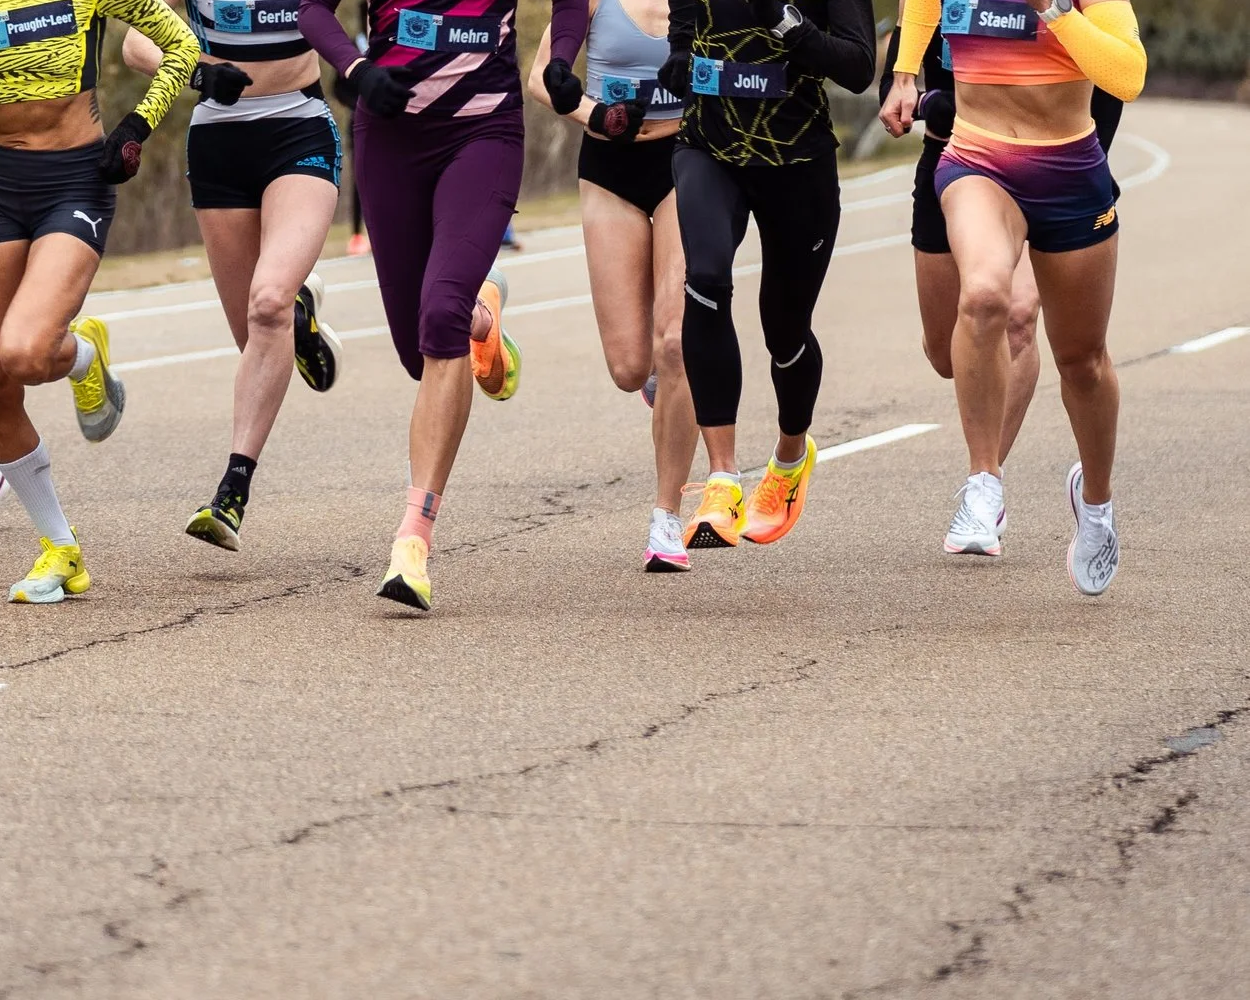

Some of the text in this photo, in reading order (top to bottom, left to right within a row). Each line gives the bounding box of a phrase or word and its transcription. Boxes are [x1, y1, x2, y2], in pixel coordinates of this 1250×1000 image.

[6, 13, 73, 34] Praught-Leer
[257, 9, 299, 24] Gerlac
[978, 11, 1026, 30] Staehli
[448, 27, 489, 44] Mehra
[733, 74, 768, 92] Jolly
